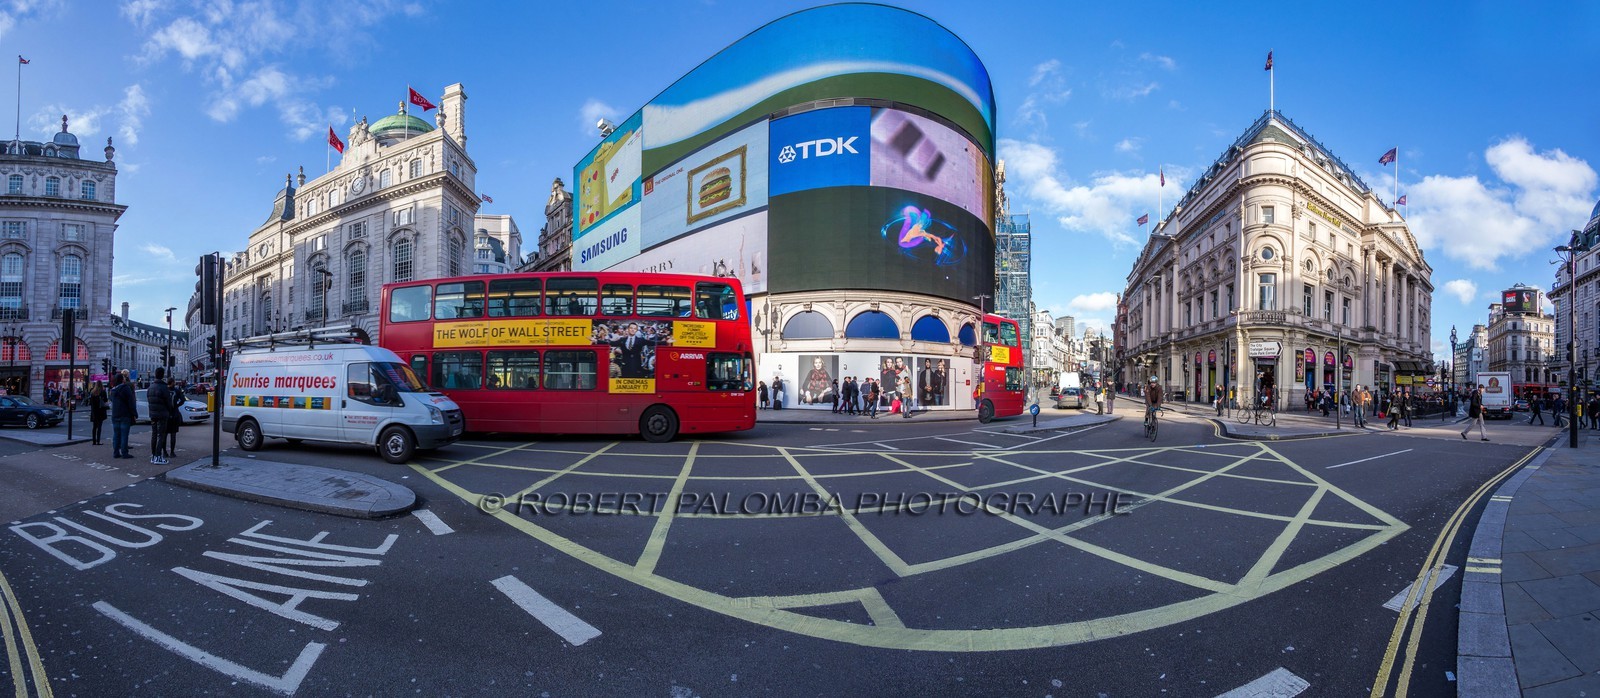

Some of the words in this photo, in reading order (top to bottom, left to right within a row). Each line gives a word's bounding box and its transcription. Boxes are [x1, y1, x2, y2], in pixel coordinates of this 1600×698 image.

[796, 136, 859, 160] TDK
[581, 227, 628, 264] SAMSUNG
[436, 329, 456, 340] THE
[459, 328, 489, 339] WOLF
[491, 327, 505, 338] OF
[508, 327, 540, 337] WALL
[543, 326, 587, 337] STREET
[232, 372, 270, 389] Sunrise
[274, 375, 337, 393] marquees
[8, 502, 204, 571] BUS
[92, 520, 399, 696] LANE
